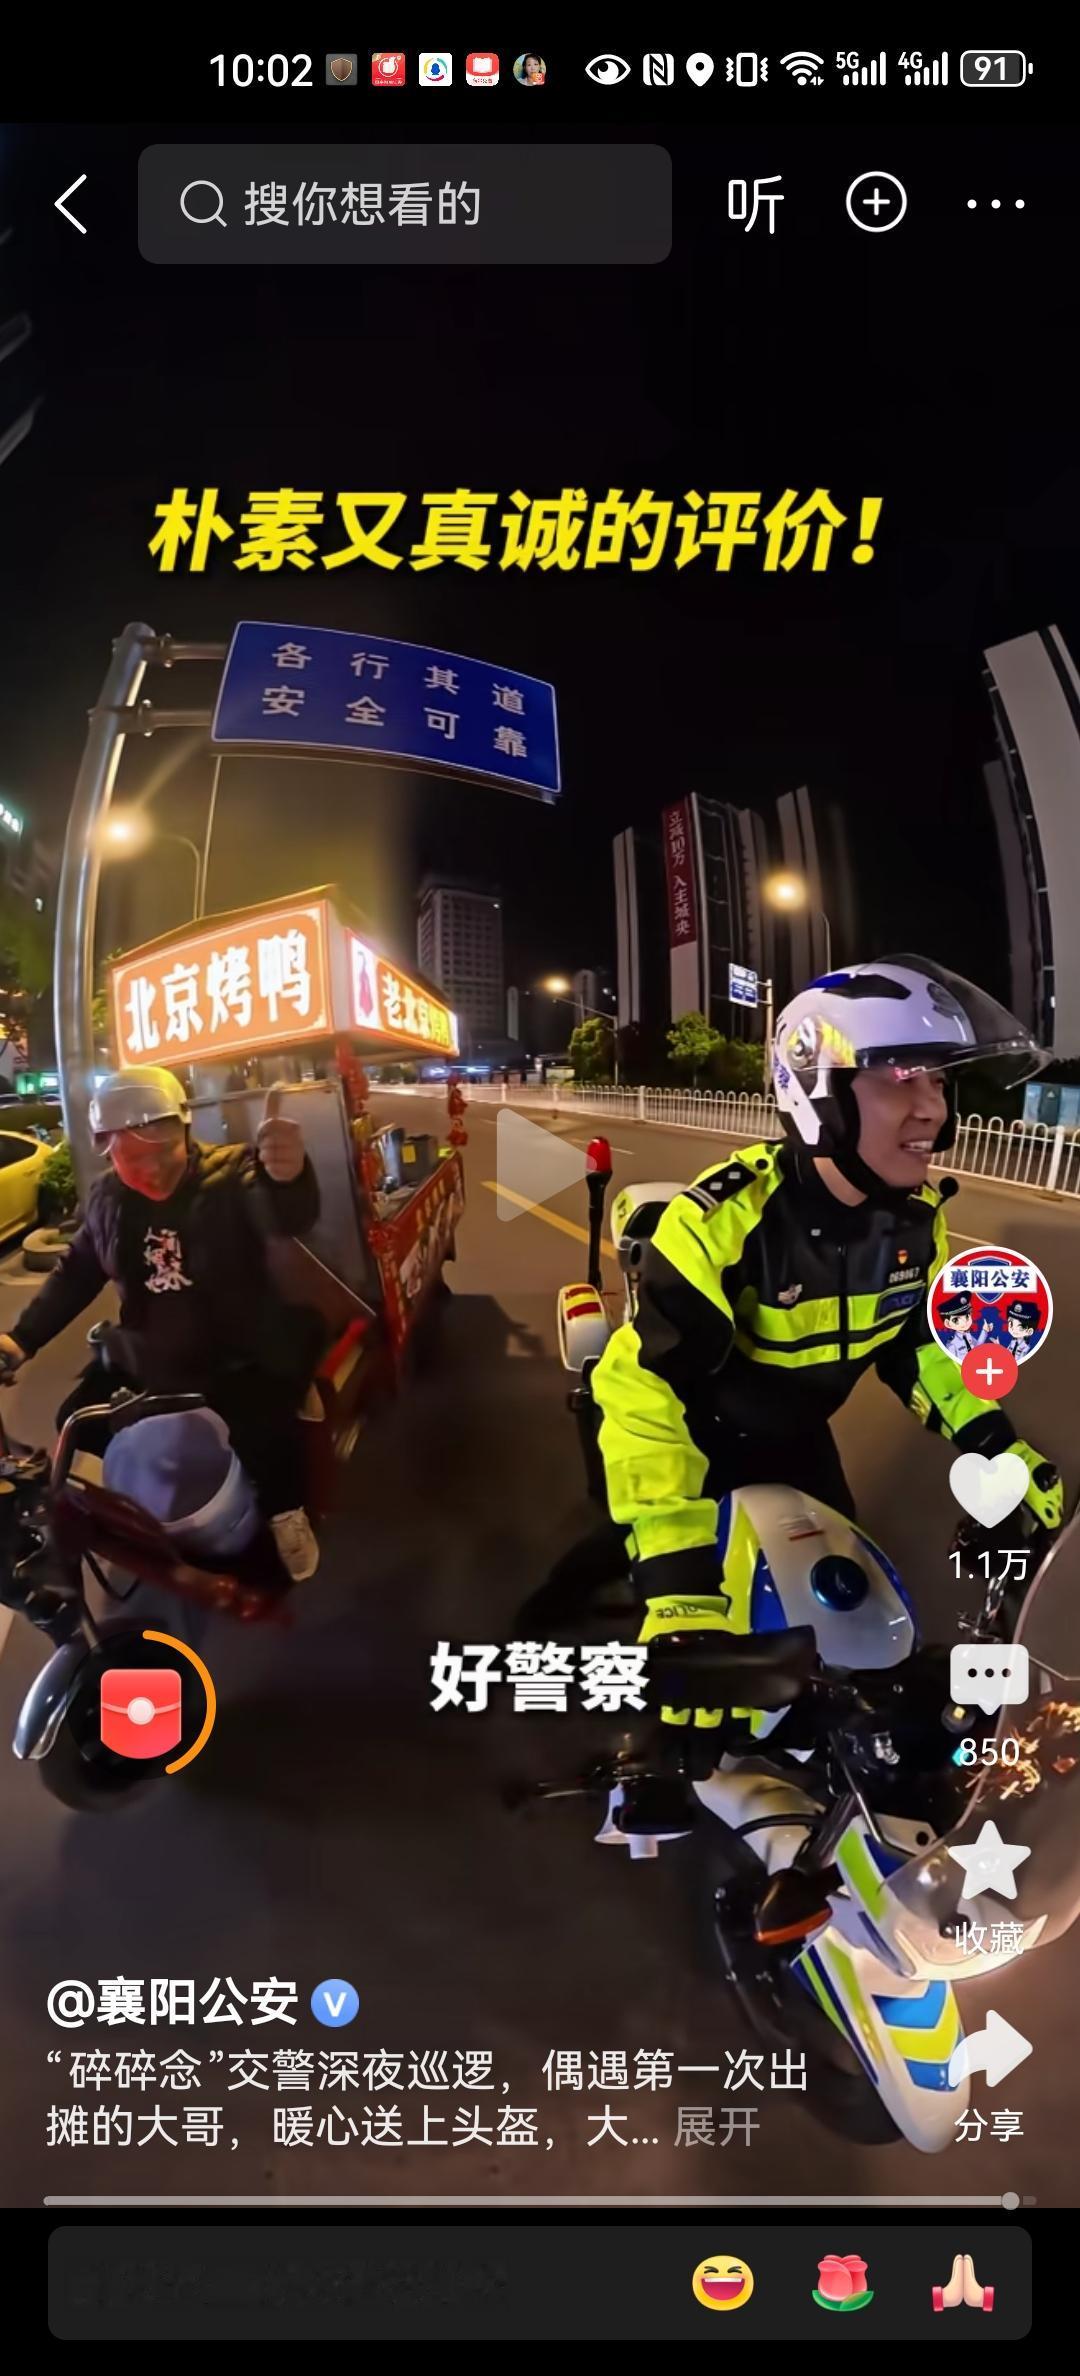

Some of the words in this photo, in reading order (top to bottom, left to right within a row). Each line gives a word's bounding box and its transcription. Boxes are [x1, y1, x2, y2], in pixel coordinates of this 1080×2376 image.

[272, 642, 526, 715] 各行其道
[262, 685, 528, 758] 安全可靠
[124, 929, 311, 1053] 北京烤鸭
